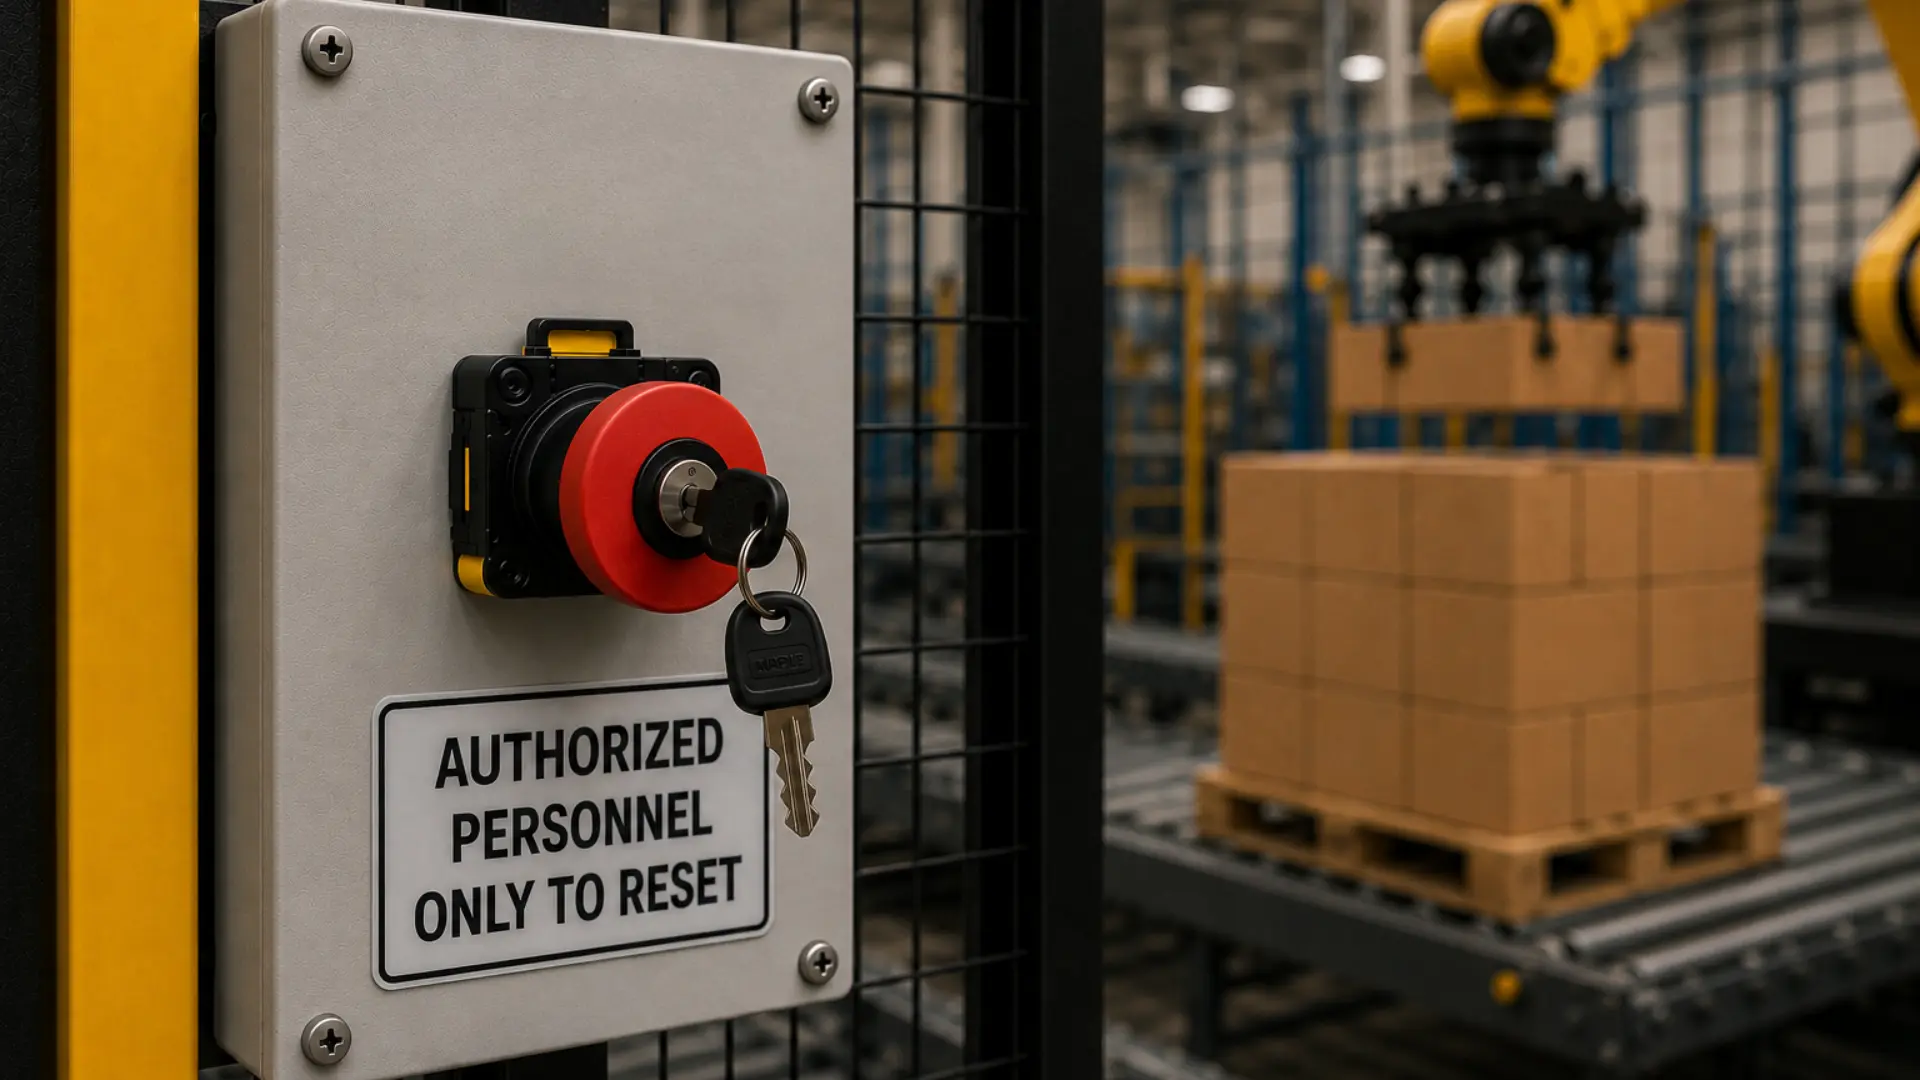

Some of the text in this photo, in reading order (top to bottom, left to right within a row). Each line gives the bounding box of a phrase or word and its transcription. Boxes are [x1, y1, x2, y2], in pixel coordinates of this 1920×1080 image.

[435, 717, 724, 789] AUTHORIZED
[452, 790, 713, 863] PERSONNEL
[414, 855, 743, 942] ONLY TO RESET
